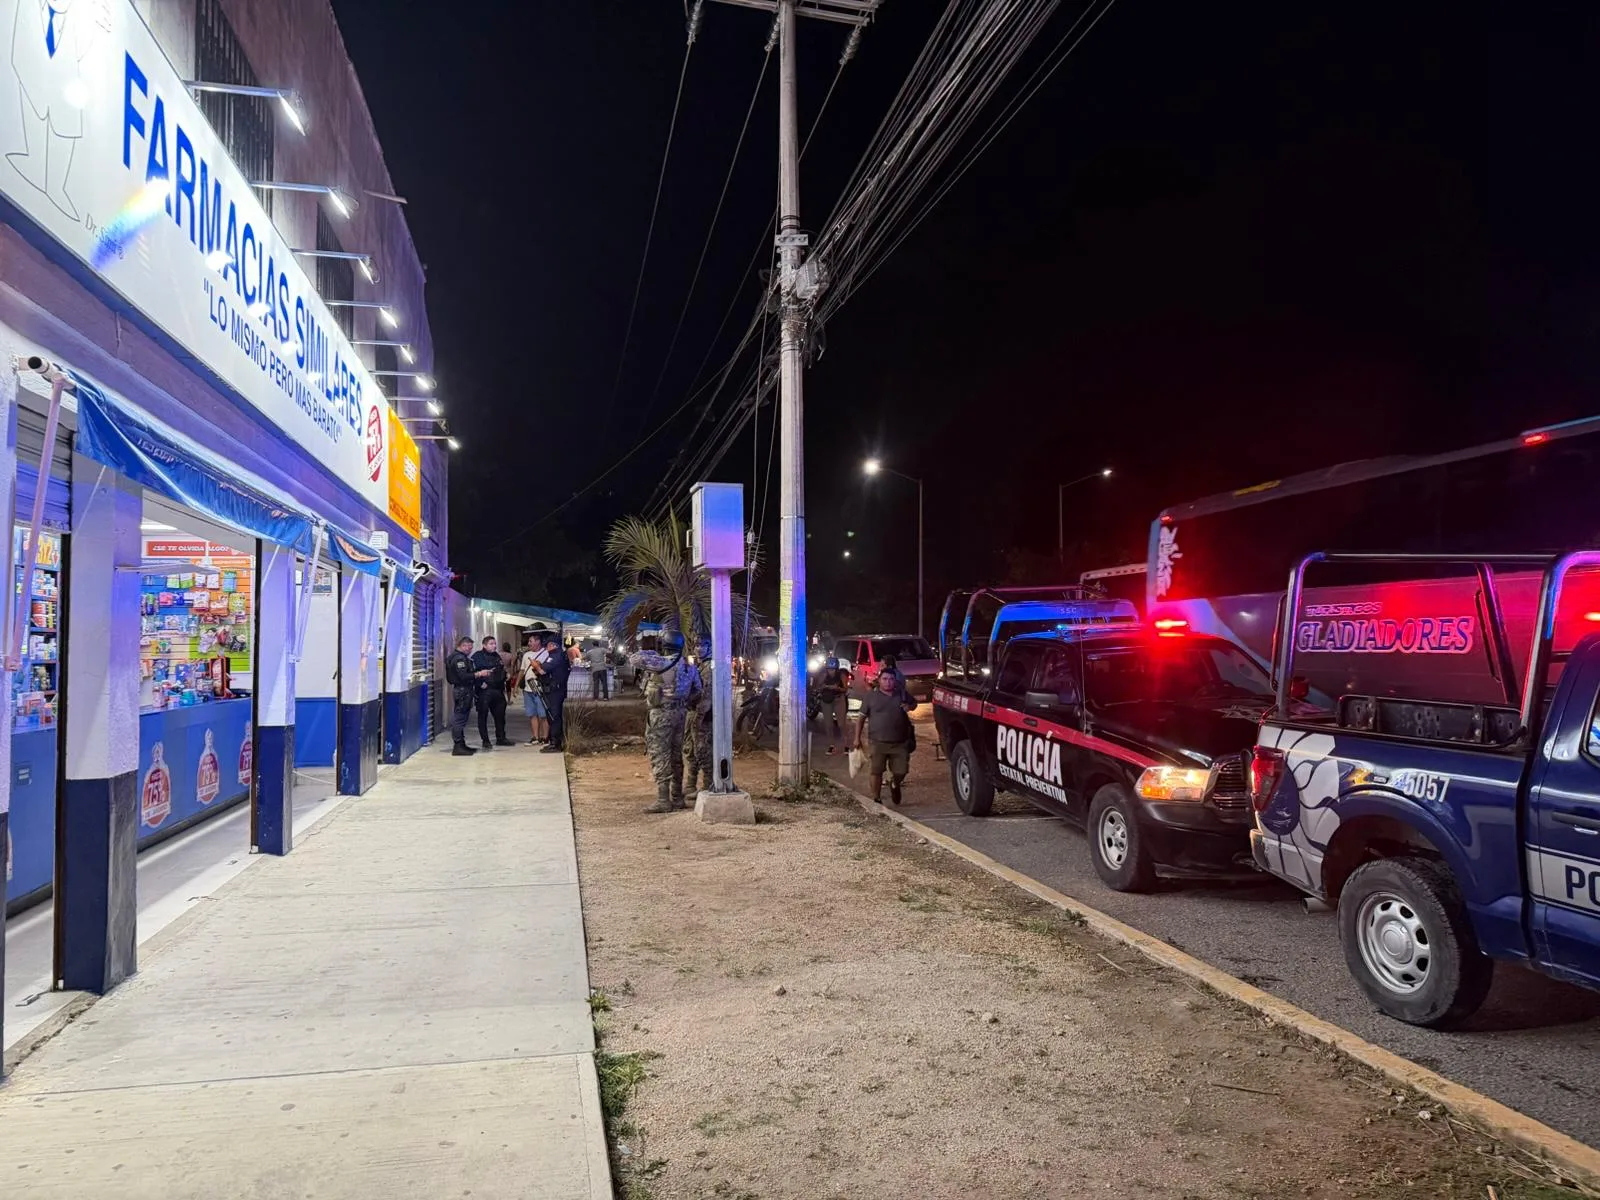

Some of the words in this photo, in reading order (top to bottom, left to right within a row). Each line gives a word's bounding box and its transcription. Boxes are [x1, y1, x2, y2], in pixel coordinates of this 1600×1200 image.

[123, 49, 290, 343] FARMACIAS
[296, 296, 362, 436] SIMILARES
[231, 308, 267, 371] MISMO
[270, 350, 294, 398] PERO
[296, 378, 312, 417] MAS
[1297, 616, 1474, 653] GLADIADORES
[997, 724, 1063, 787] POLICÍA
[998, 762, 1027, 786] ESTATAL
[1025, 774, 1068, 805] PREVENTIVA
